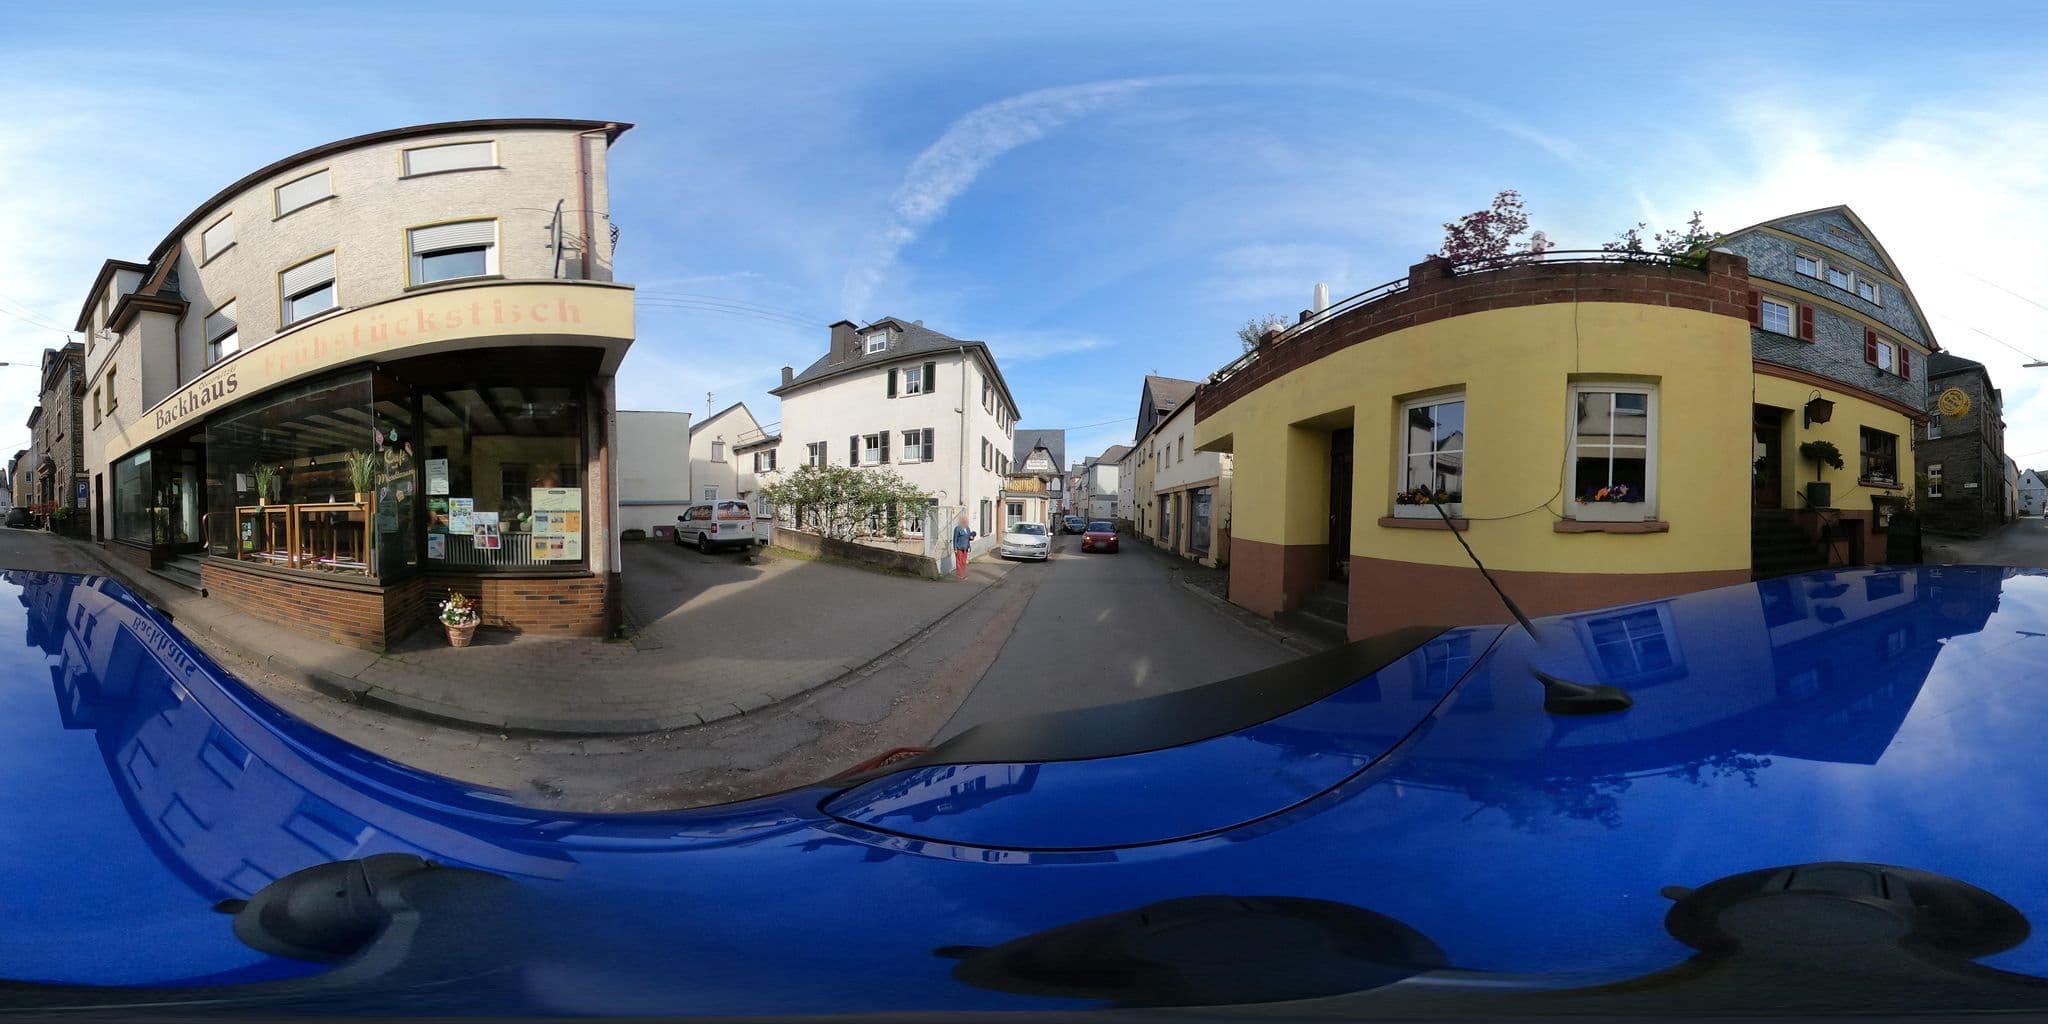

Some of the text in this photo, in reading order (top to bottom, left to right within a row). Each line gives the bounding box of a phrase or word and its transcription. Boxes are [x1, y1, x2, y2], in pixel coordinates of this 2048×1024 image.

[264, 297, 583, 377] Frühstückstisch
[156, 373, 238, 430] Backhaus
[79, 484, 86, 494] P
